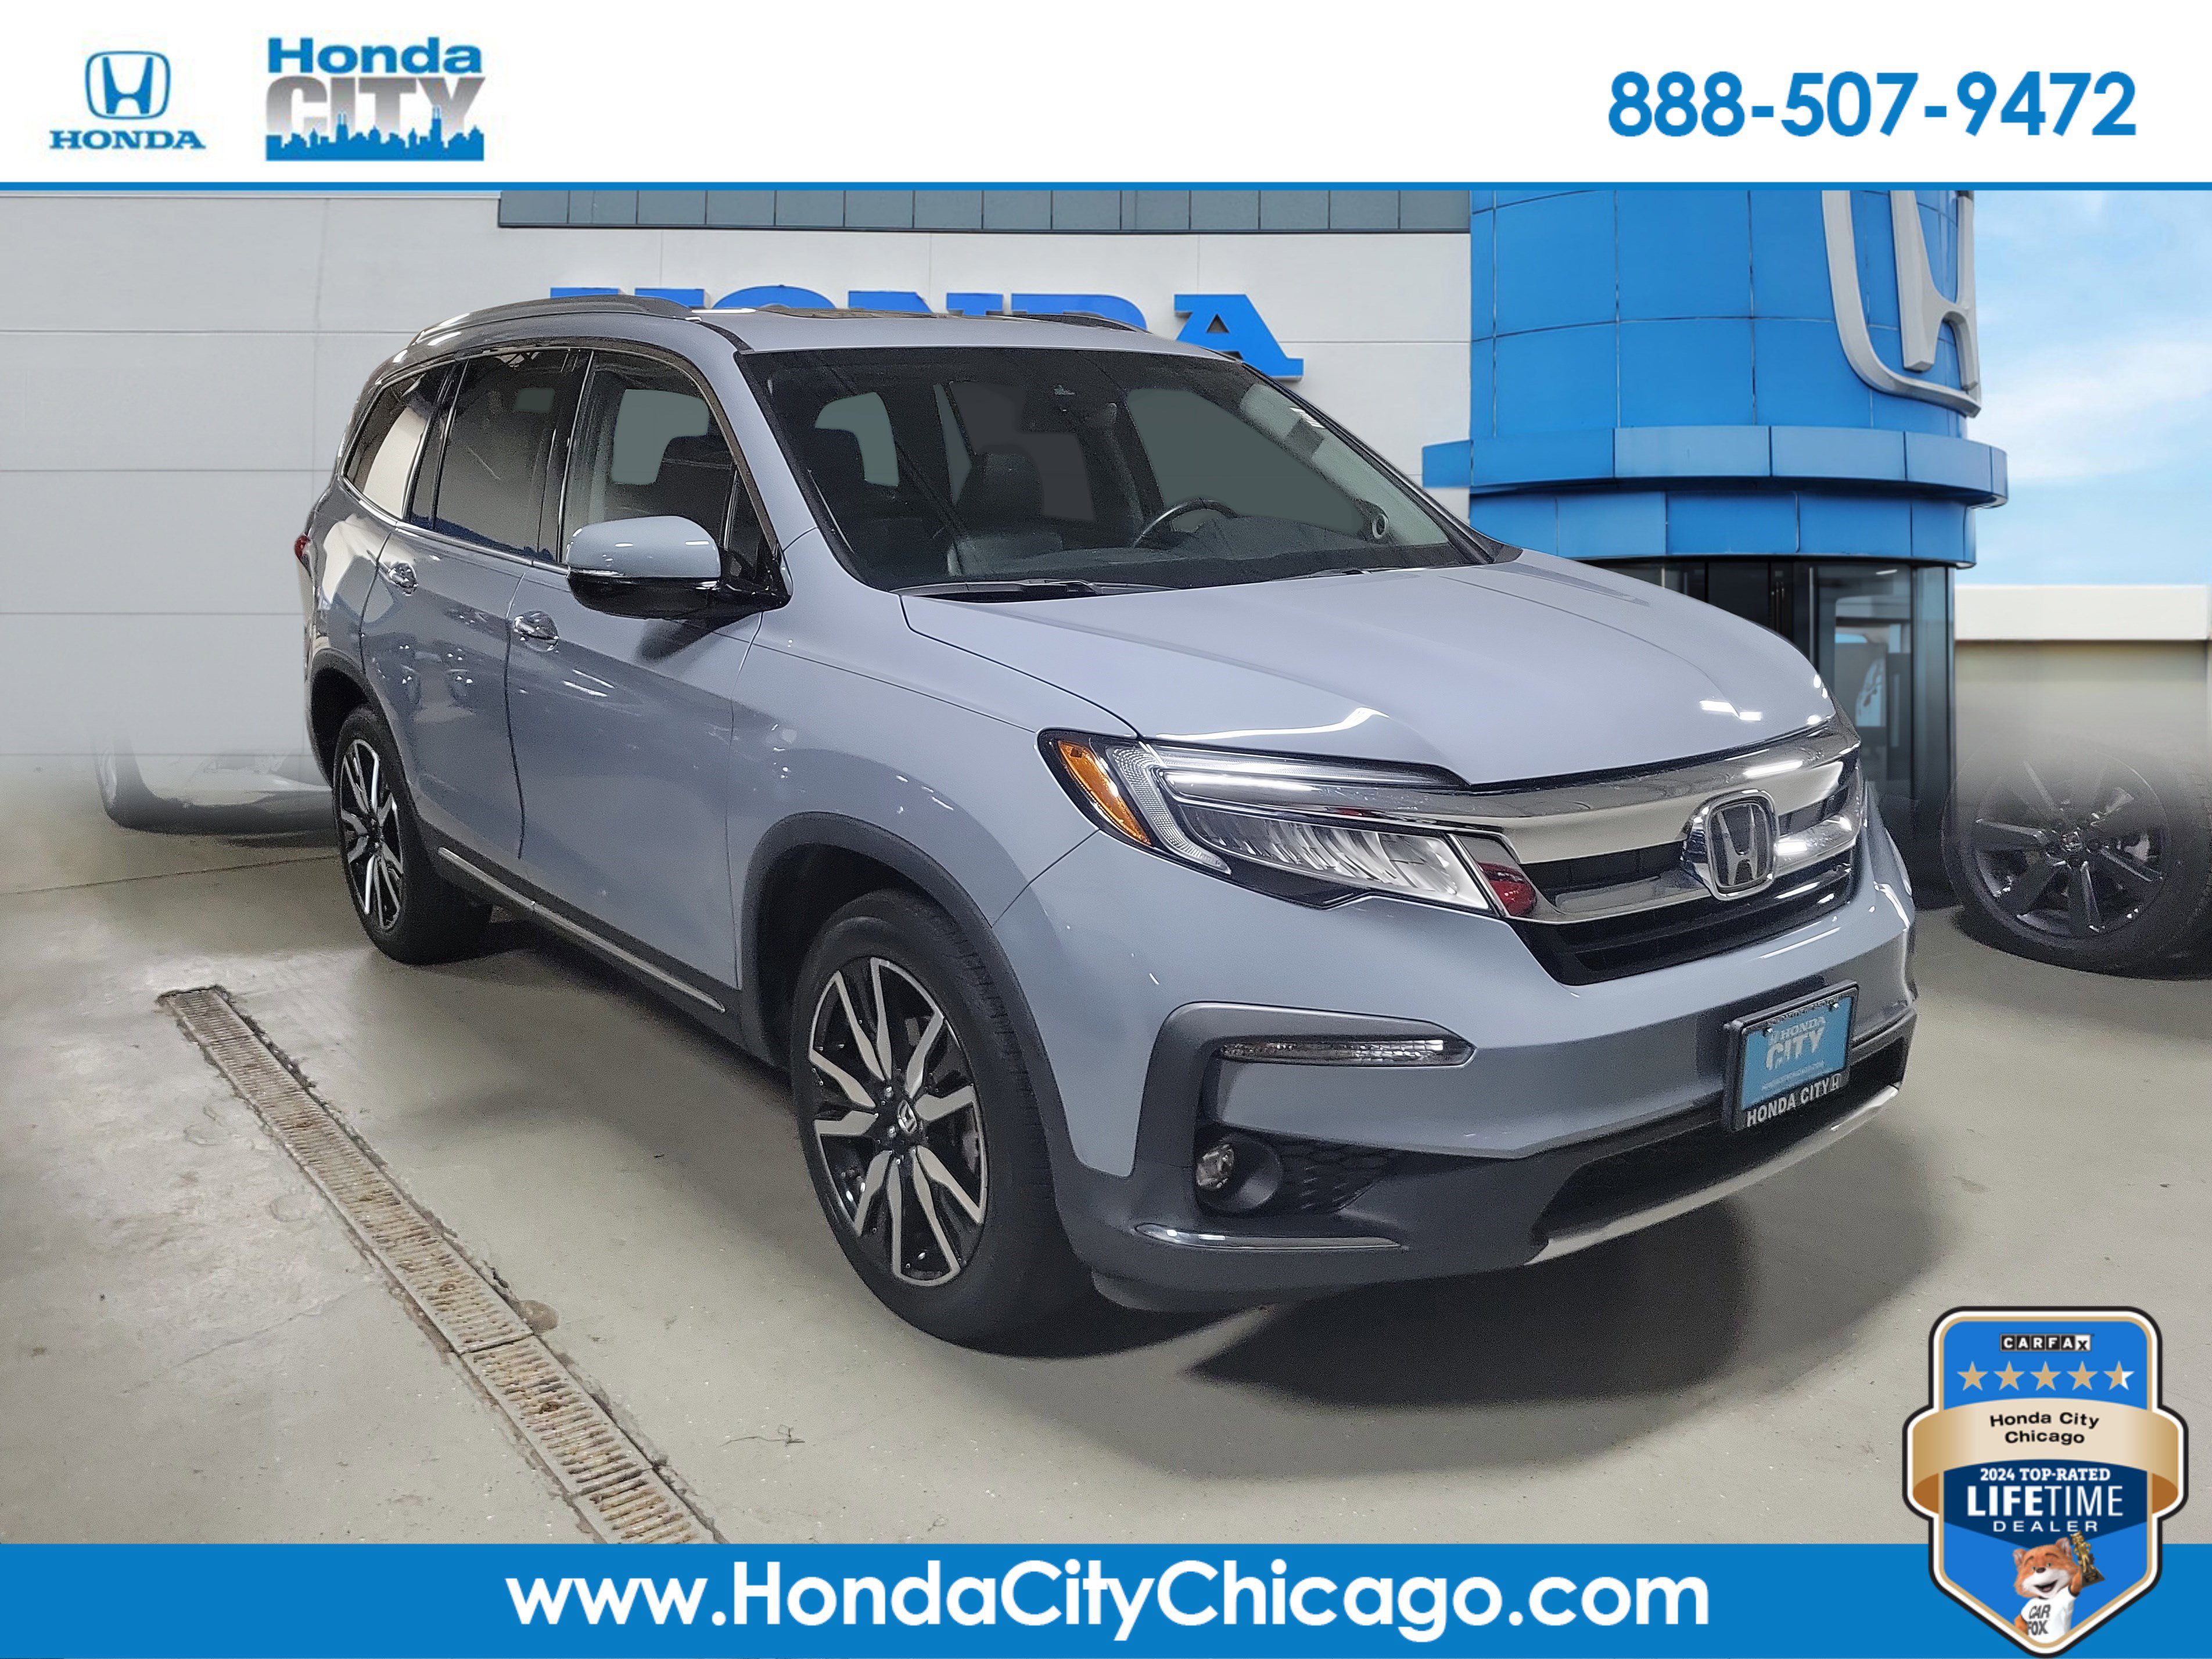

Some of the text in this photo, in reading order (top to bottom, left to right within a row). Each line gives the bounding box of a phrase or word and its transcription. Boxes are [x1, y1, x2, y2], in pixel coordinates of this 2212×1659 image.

[1765, 1026, 1825, 1071] CITY
[1747, 1093, 1797, 1127] HONDA
[1800, 1077, 1830, 1104] CITY
